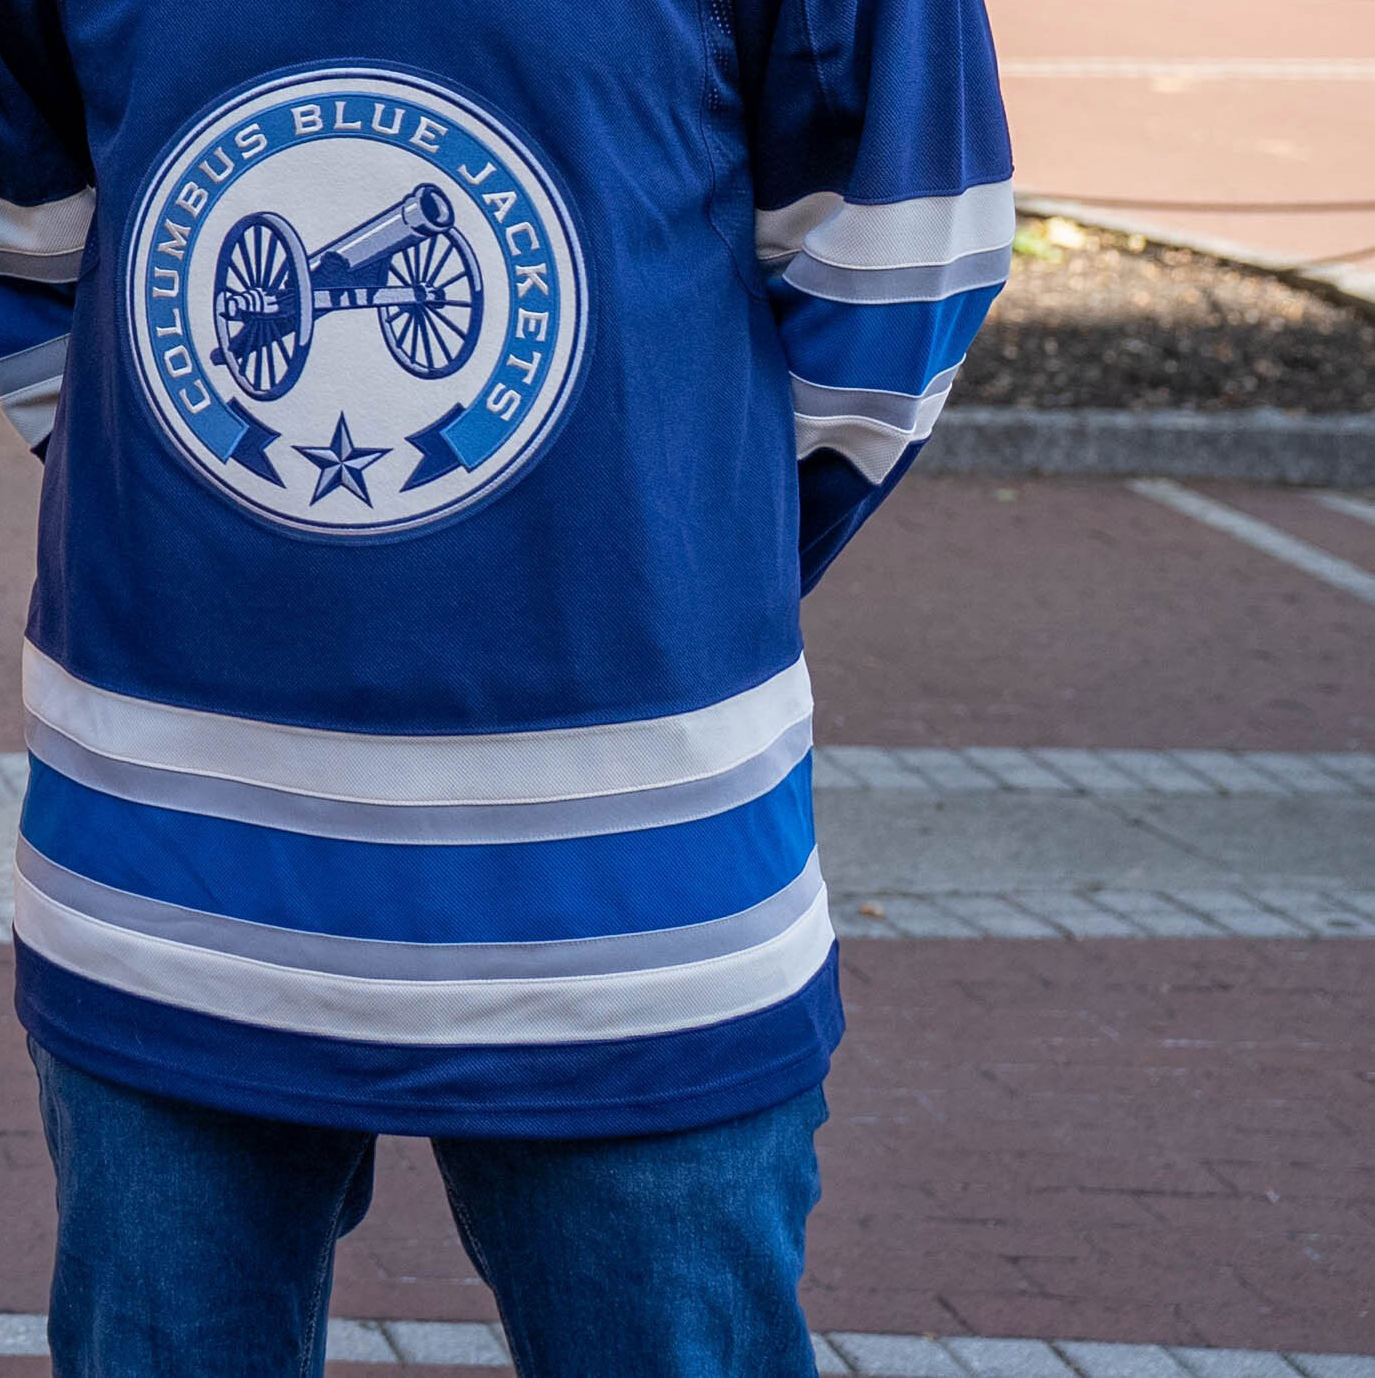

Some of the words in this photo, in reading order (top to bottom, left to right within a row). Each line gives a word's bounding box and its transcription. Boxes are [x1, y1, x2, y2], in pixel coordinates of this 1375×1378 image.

[152, 123, 269, 415] COLUMBUS
[290, 102, 449, 154] BLUE
[456, 160, 550, 422] JACKETS
